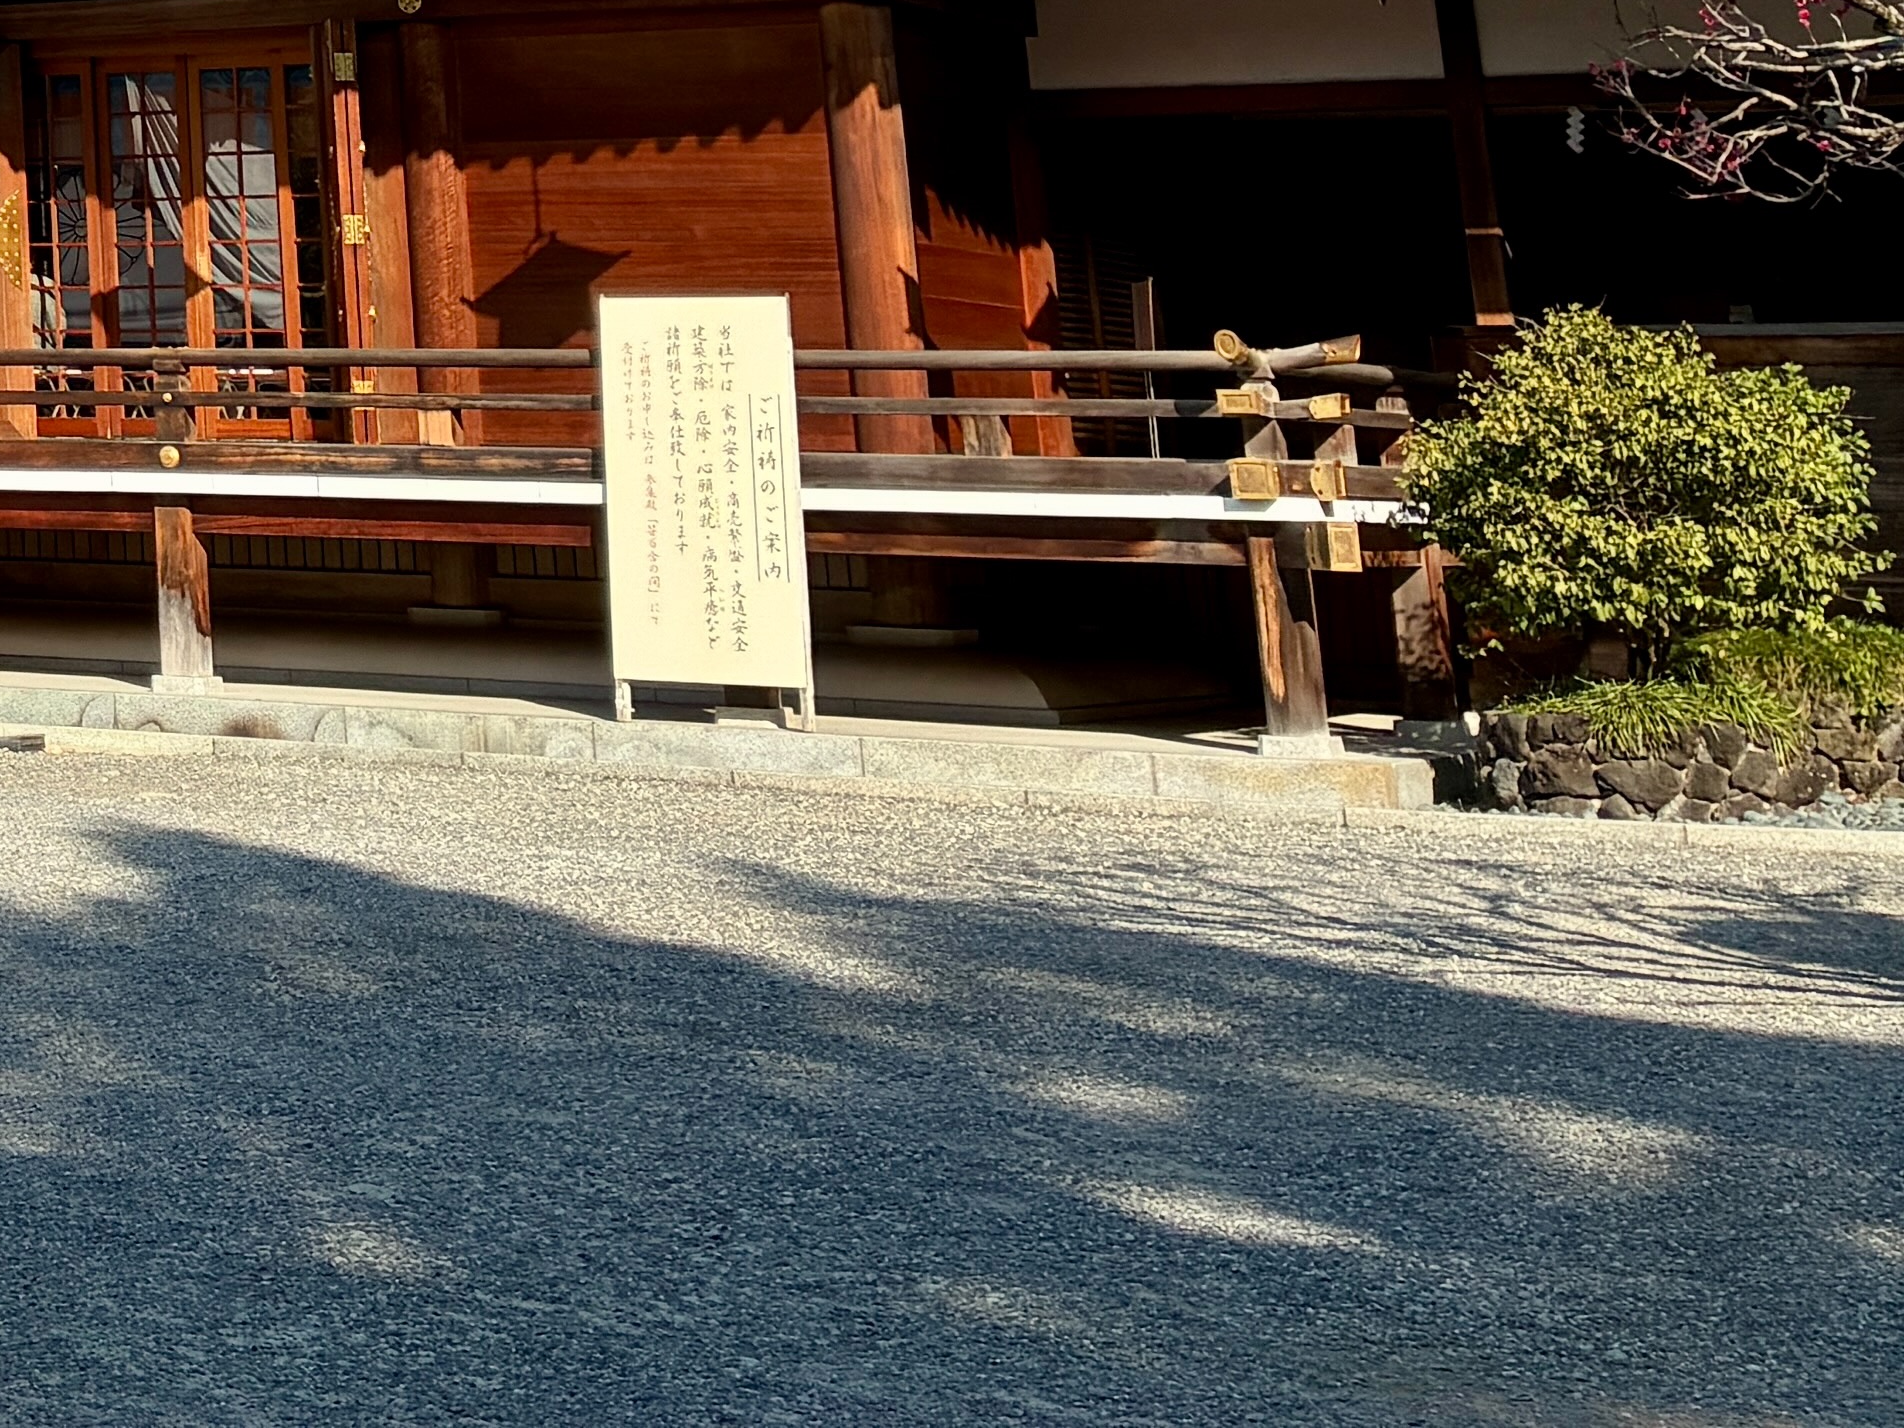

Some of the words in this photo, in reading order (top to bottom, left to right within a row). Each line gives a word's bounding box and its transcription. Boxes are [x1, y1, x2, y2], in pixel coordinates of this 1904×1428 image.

[756, 396, 782, 579] ご祈祷のご案内
